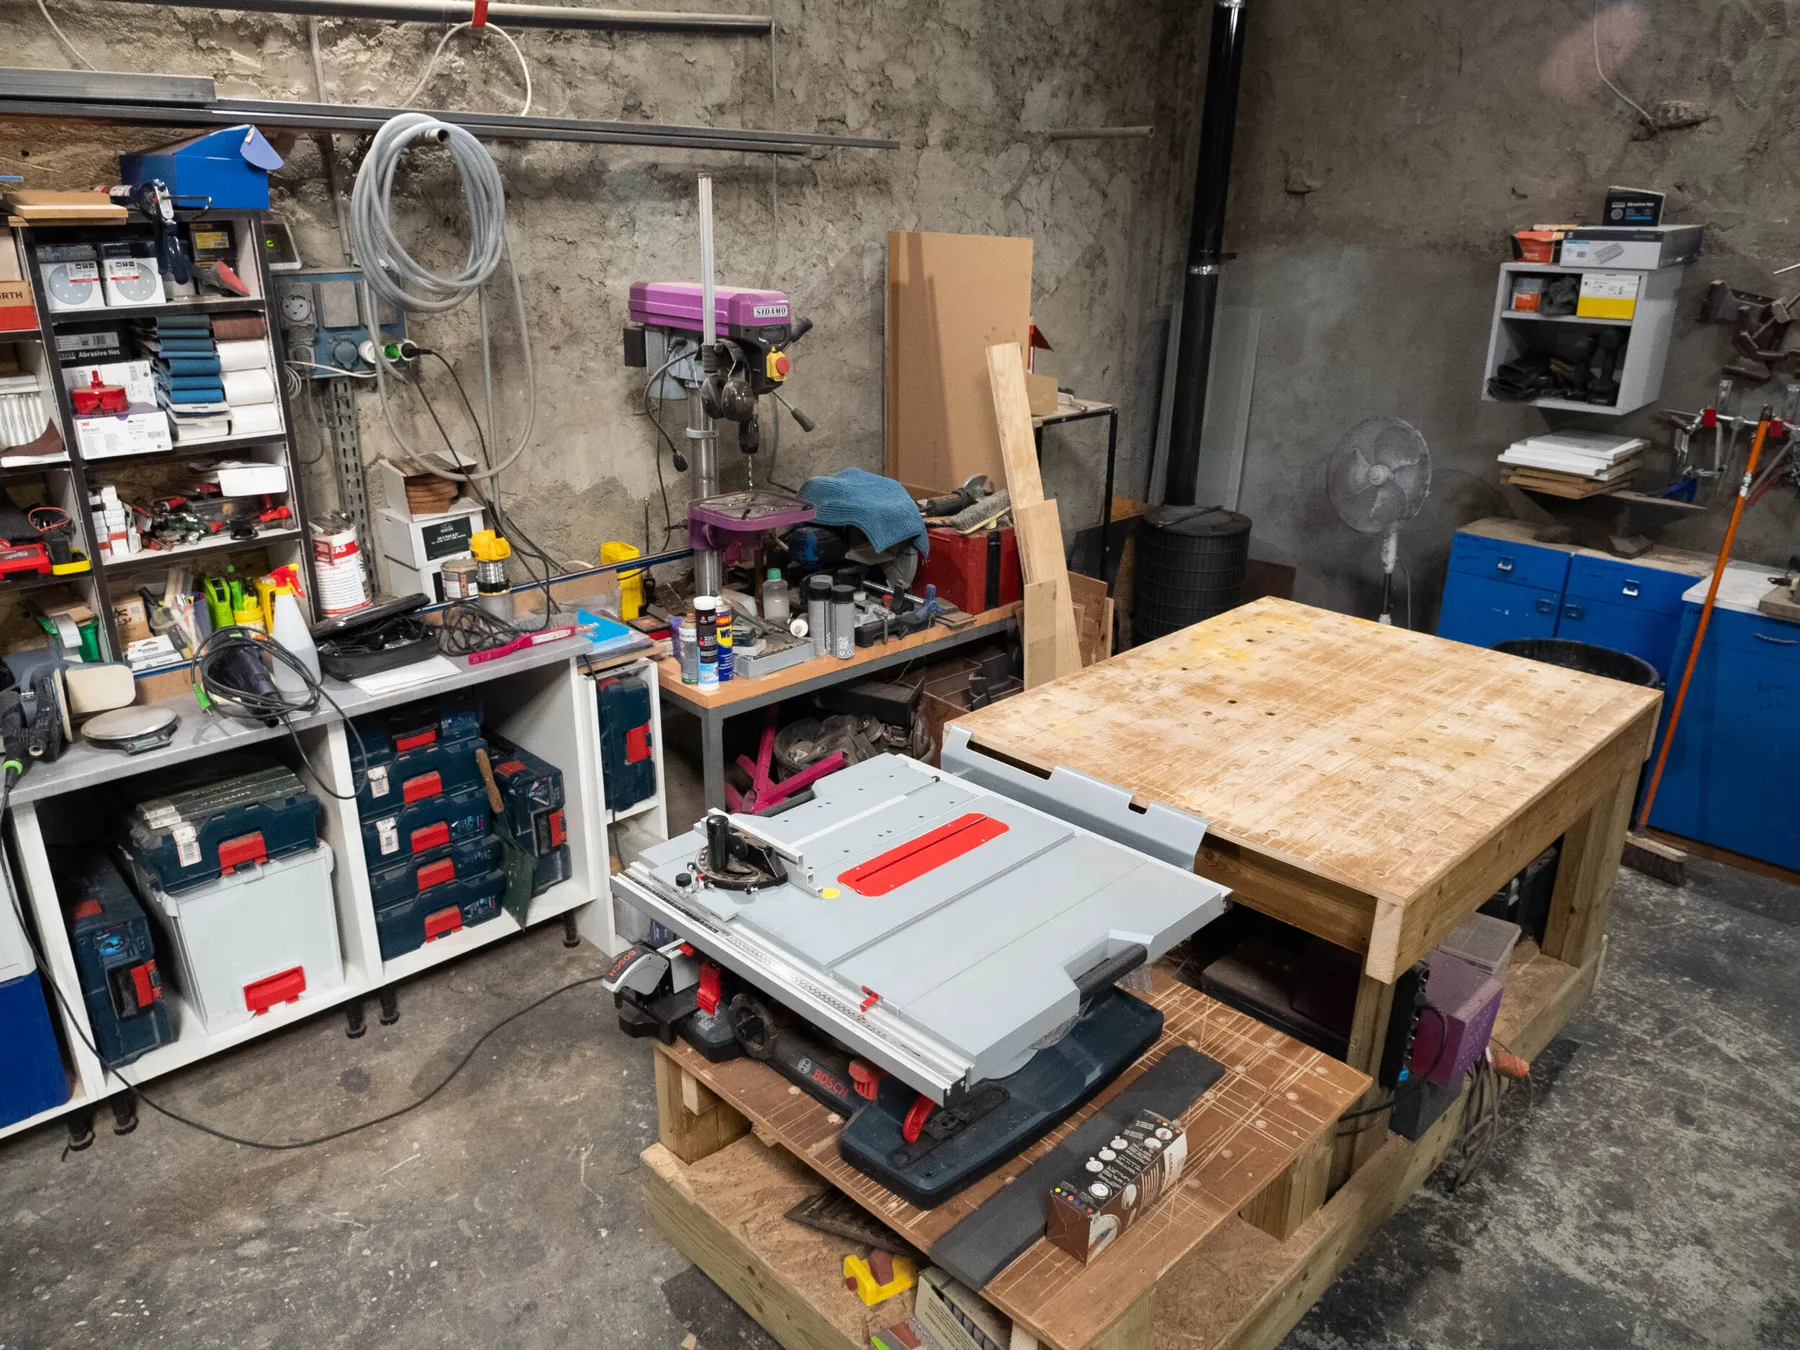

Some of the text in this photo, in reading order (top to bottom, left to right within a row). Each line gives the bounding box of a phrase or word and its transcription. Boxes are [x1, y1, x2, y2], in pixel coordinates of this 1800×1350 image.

[756, 307, 786, 316] SIDAMO
[78, 350, 107, 358] Abrasive
[608, 949, 637, 977] BOSCH
[812, 1068, 849, 1099] BOSCH
